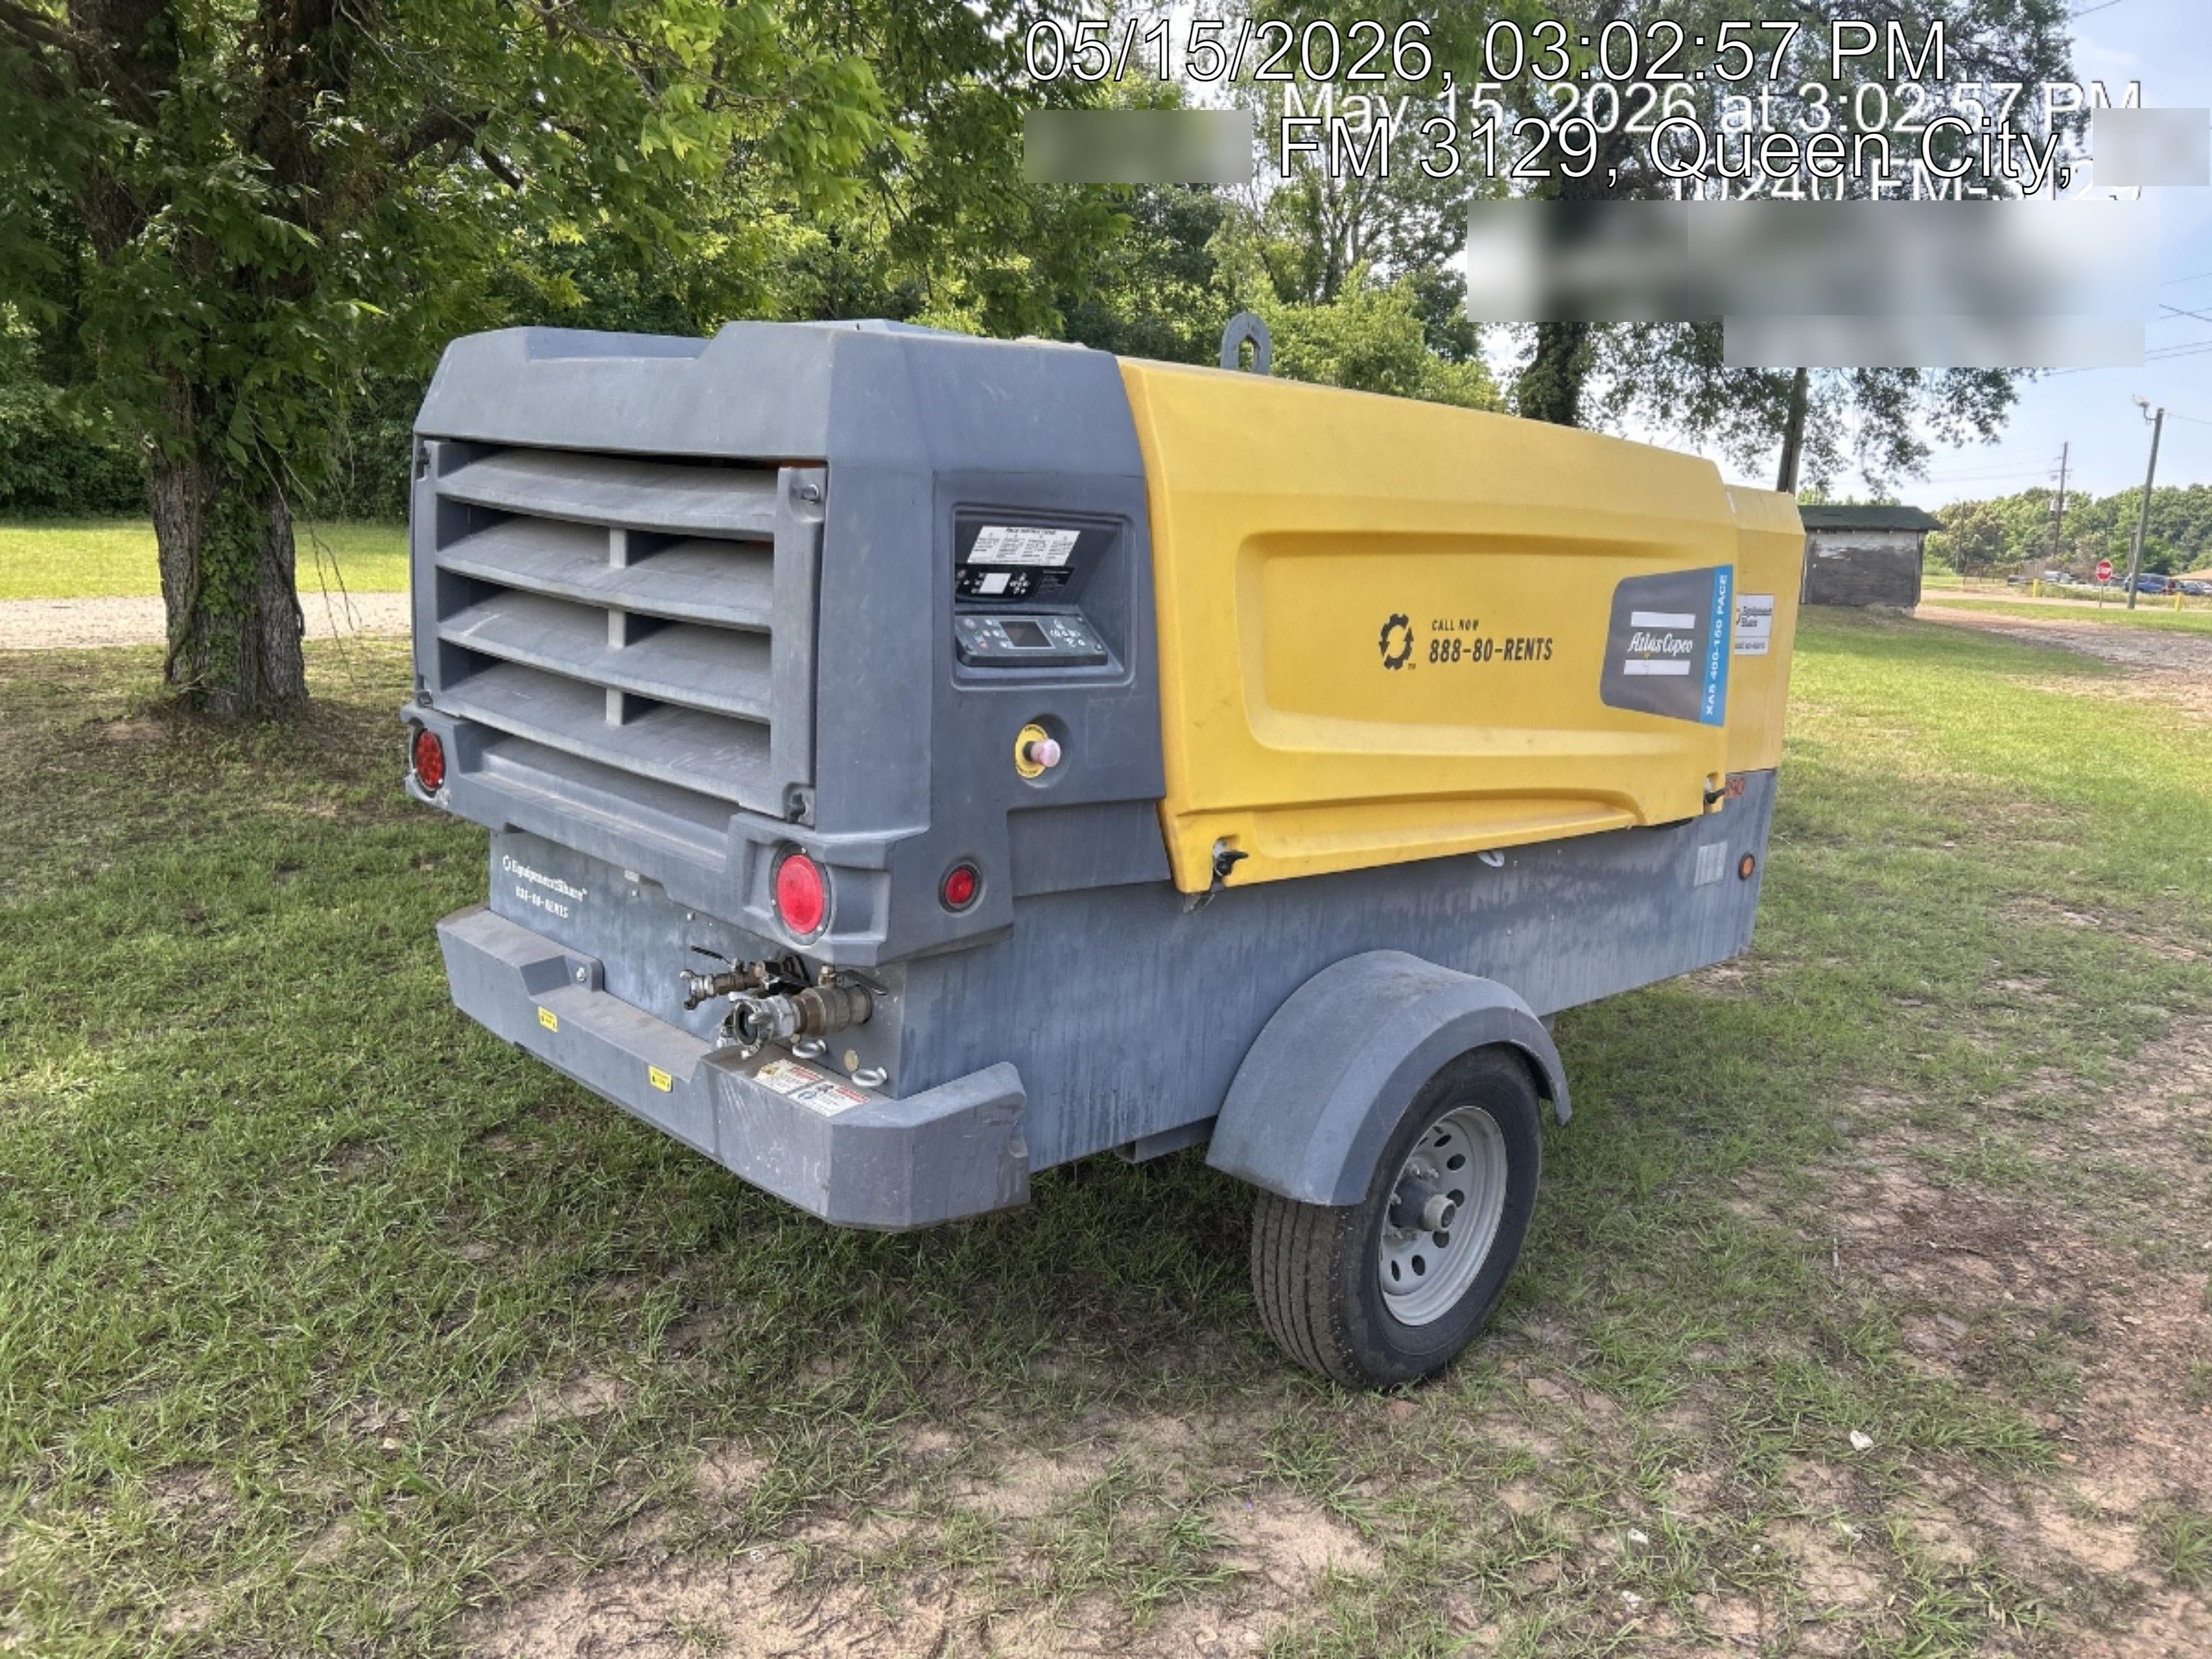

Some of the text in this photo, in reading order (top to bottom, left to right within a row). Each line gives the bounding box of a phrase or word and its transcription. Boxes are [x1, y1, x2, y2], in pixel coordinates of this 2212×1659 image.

[1432, 619, 1480, 631] CALL NOW
[1429, 637, 1553, 664] 888-80-RENTS
